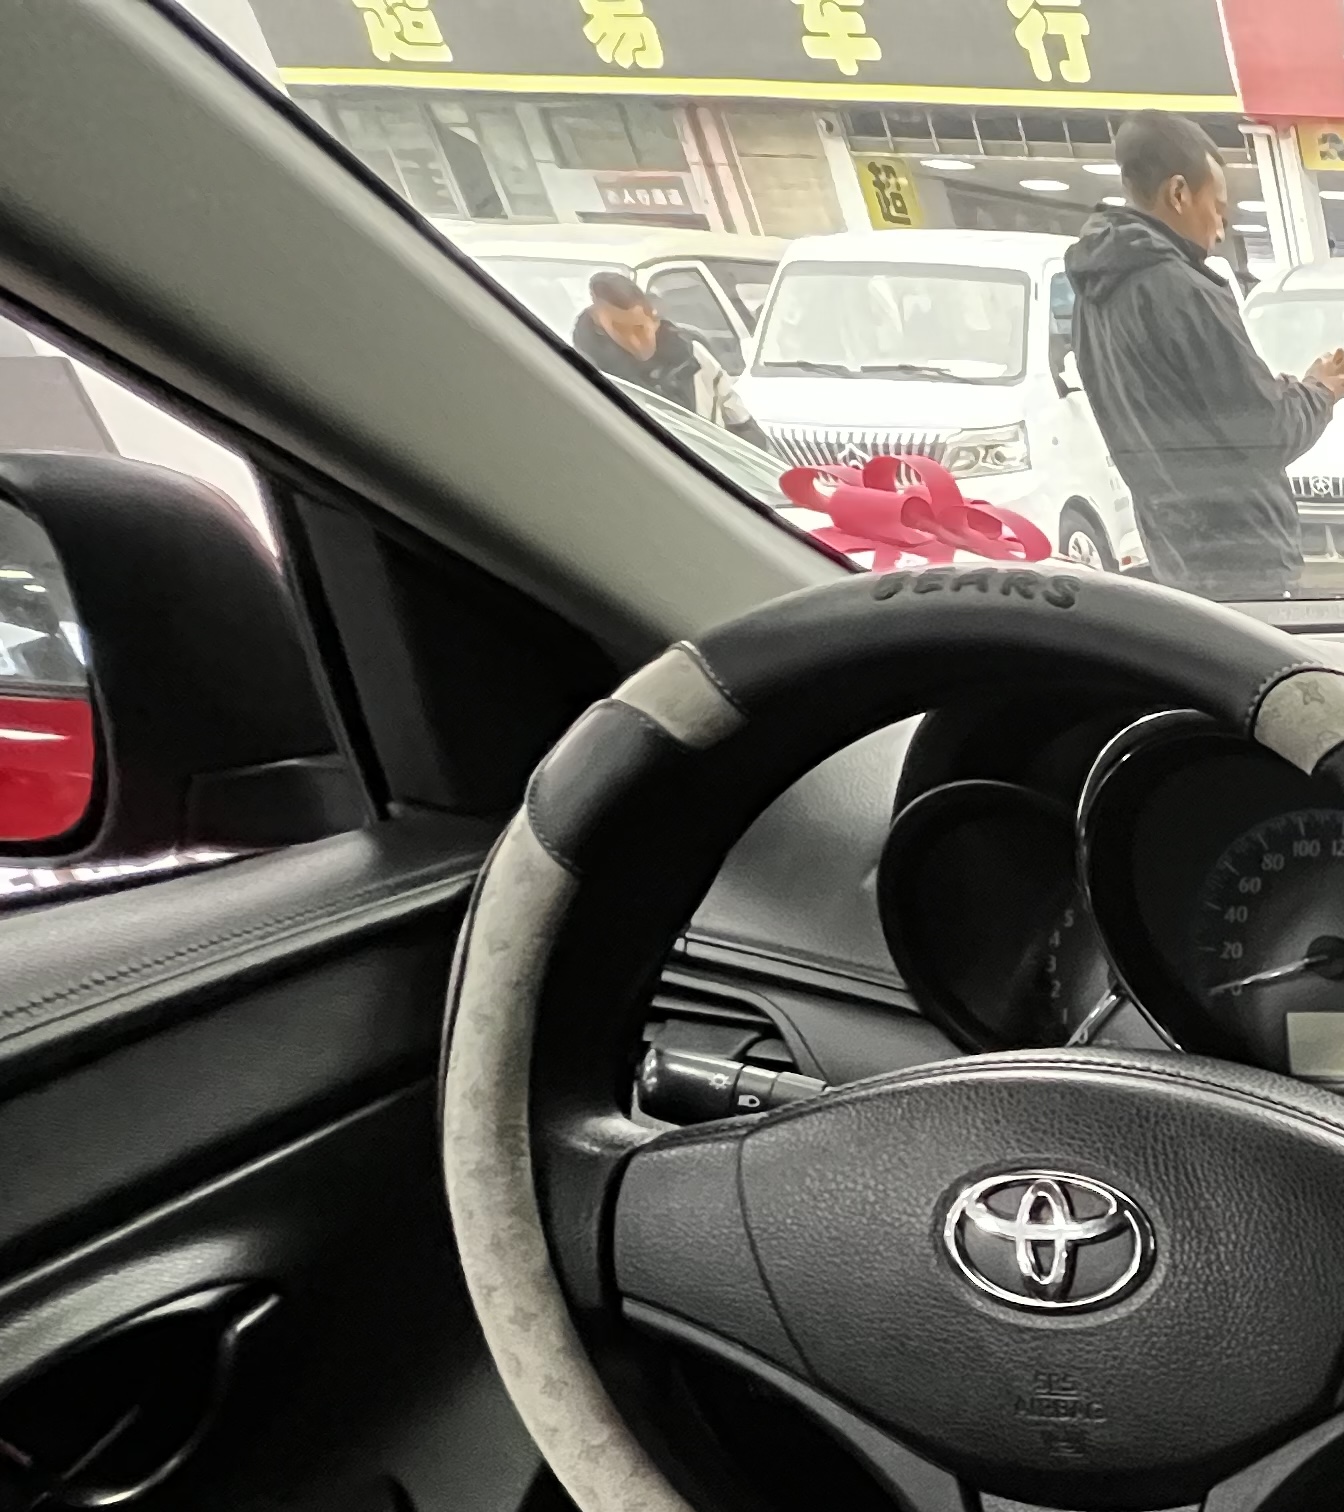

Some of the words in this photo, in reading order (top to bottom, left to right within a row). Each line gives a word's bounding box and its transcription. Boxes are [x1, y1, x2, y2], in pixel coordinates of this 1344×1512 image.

[1292, 839, 1321, 858] 100
[1261, 853, 1285, 872] 80
[1238, 876, 1262, 894] 60
[1223, 905, 1248, 923] 40
[1219, 942, 1244, 960] 20
